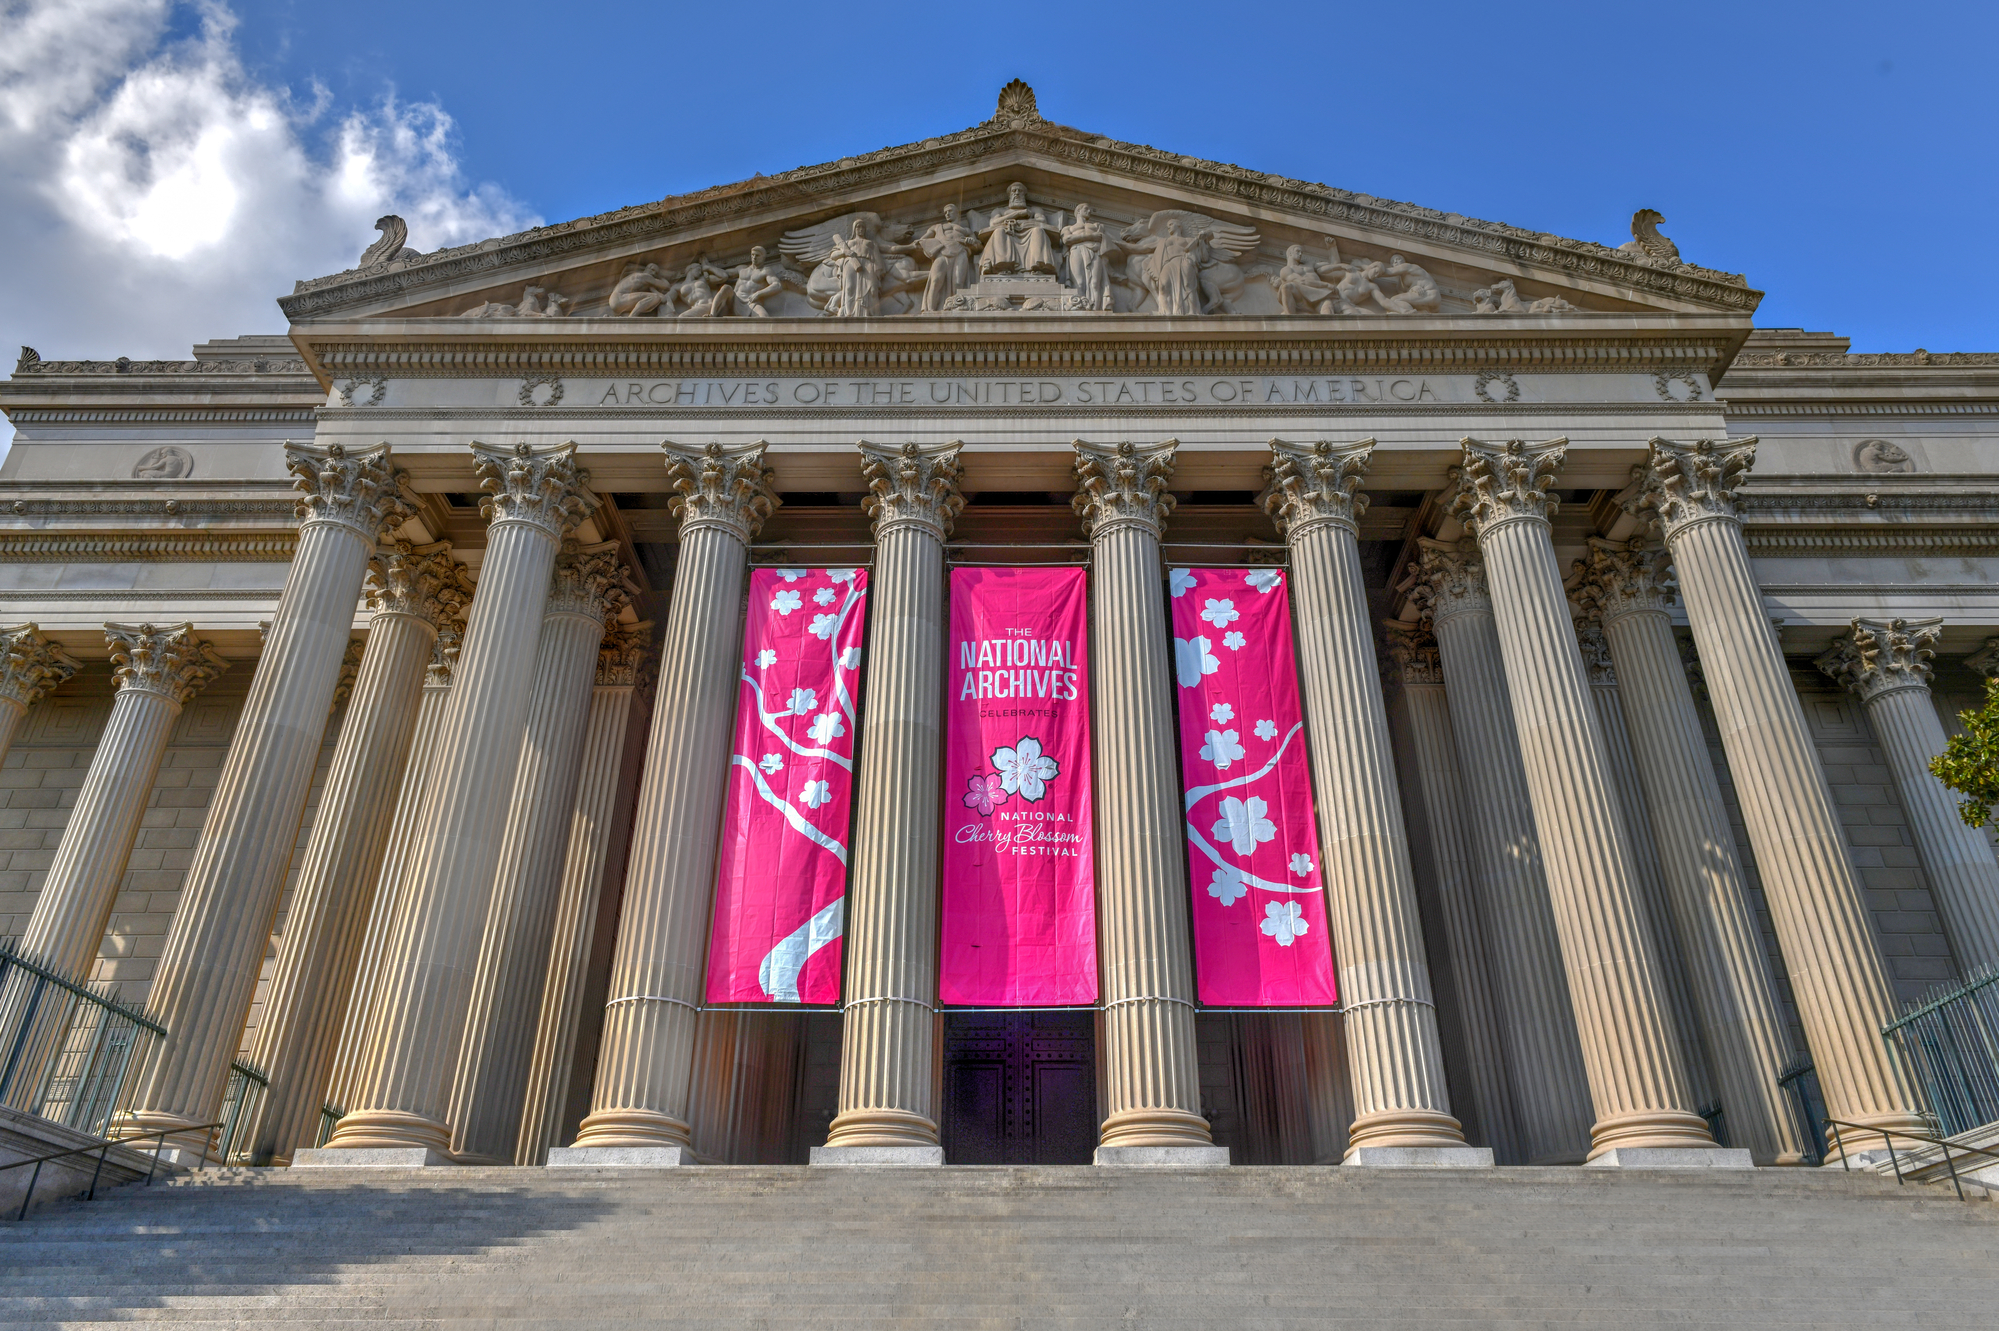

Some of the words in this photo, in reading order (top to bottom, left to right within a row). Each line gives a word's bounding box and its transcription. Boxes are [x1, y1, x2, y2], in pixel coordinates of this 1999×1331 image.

[600, 382, 779, 404] ARCHIVES
[794, 382, 839, 404] OF
[849, 382, 916, 404] THE
[929, 381, 1063, 404] UNITED
[1077, 381, 1197, 403] STATES
[1210, 380, 1253, 402] OF
[1266, 379, 1441, 402] AMERICA
[1005, 628, 1032, 636] THE
[961, 639, 1077, 669] NATIONAL
[960, 669, 1078, 701] ARCHIVES
[980, 709, 1058, 718] CELEBRATES
[1001, 812, 1073, 822] NATIONAL
[955, 823, 1012, 853] Cherry
[1013, 823, 1083, 843] Blossom
[1012, 846, 1078, 856] FESTIVAL
